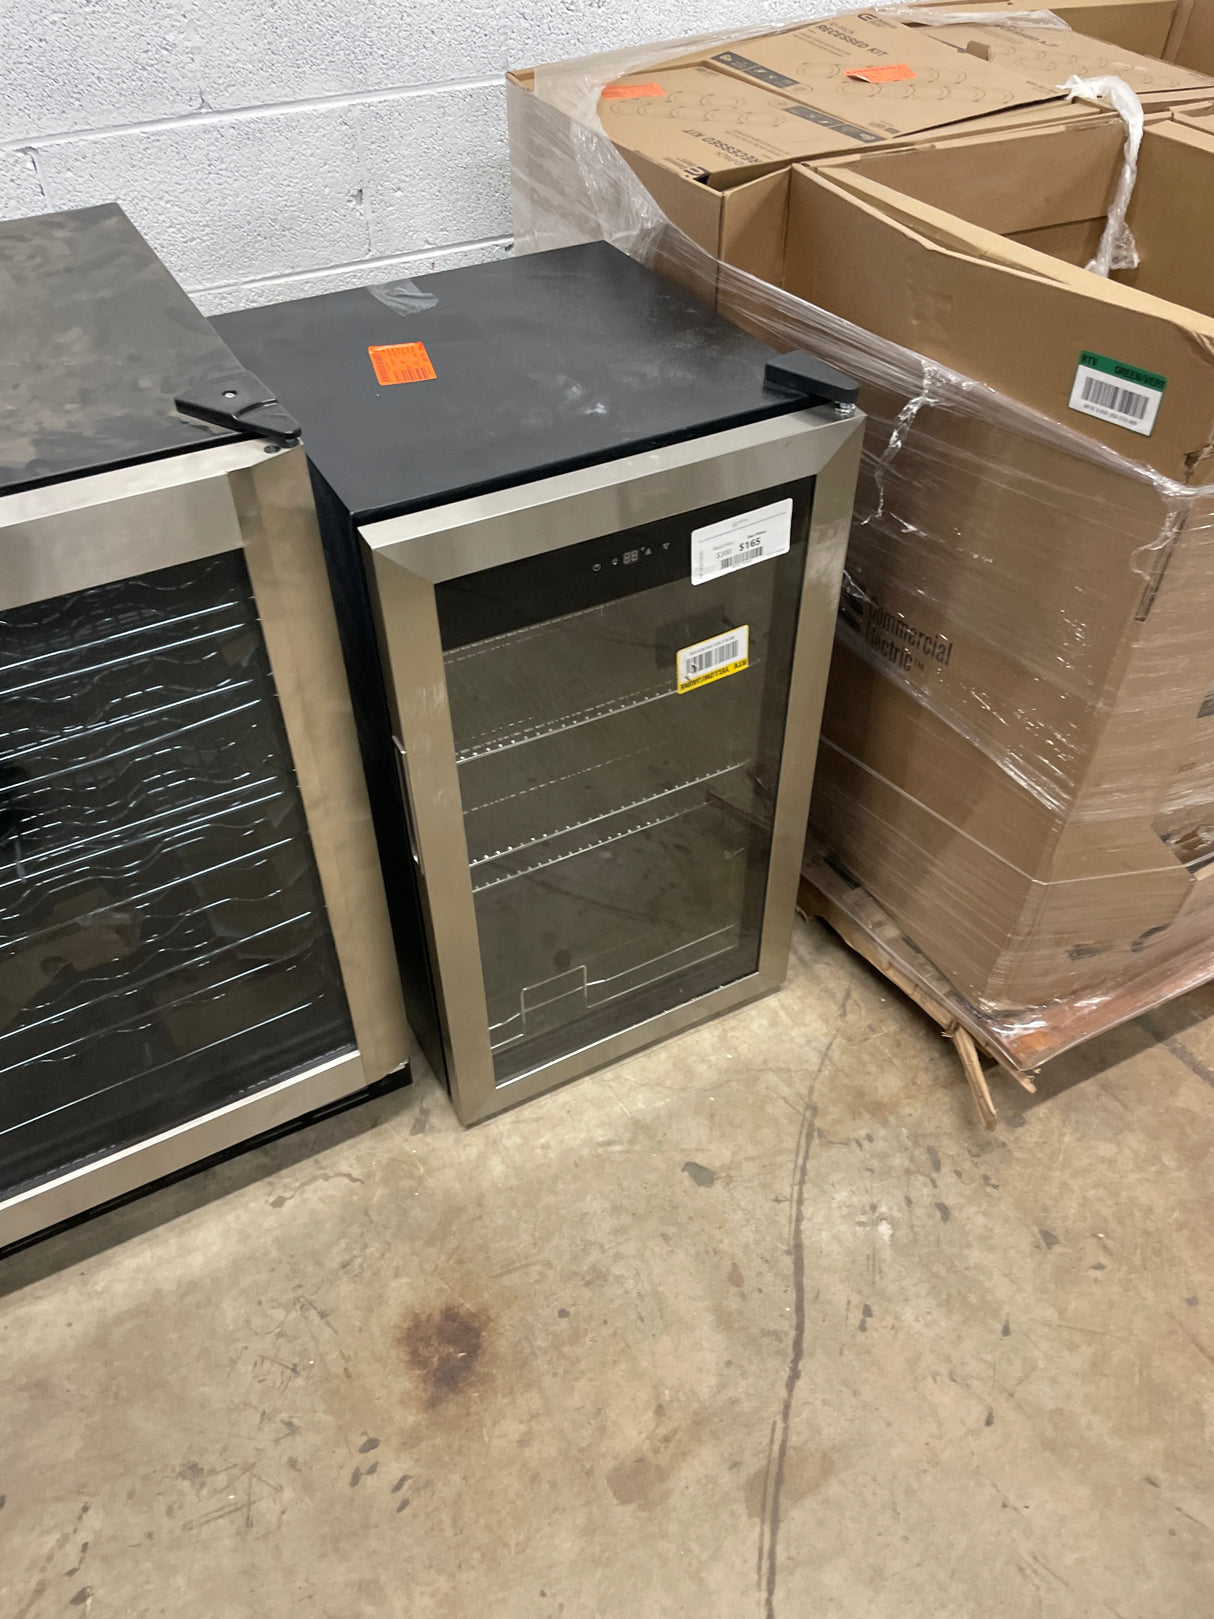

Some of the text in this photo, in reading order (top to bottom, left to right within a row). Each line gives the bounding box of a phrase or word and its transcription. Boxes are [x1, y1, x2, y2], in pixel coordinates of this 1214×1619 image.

[815, 24, 869, 49] RECESSED
[866, 47, 889, 56] KIT
[682, 128, 703, 139] KIT
[703, 136, 763, 163] RECESSED
[1081, 353, 1167, 388] RTV GREEN/VERT
[739, 537, 761, 551] $165
